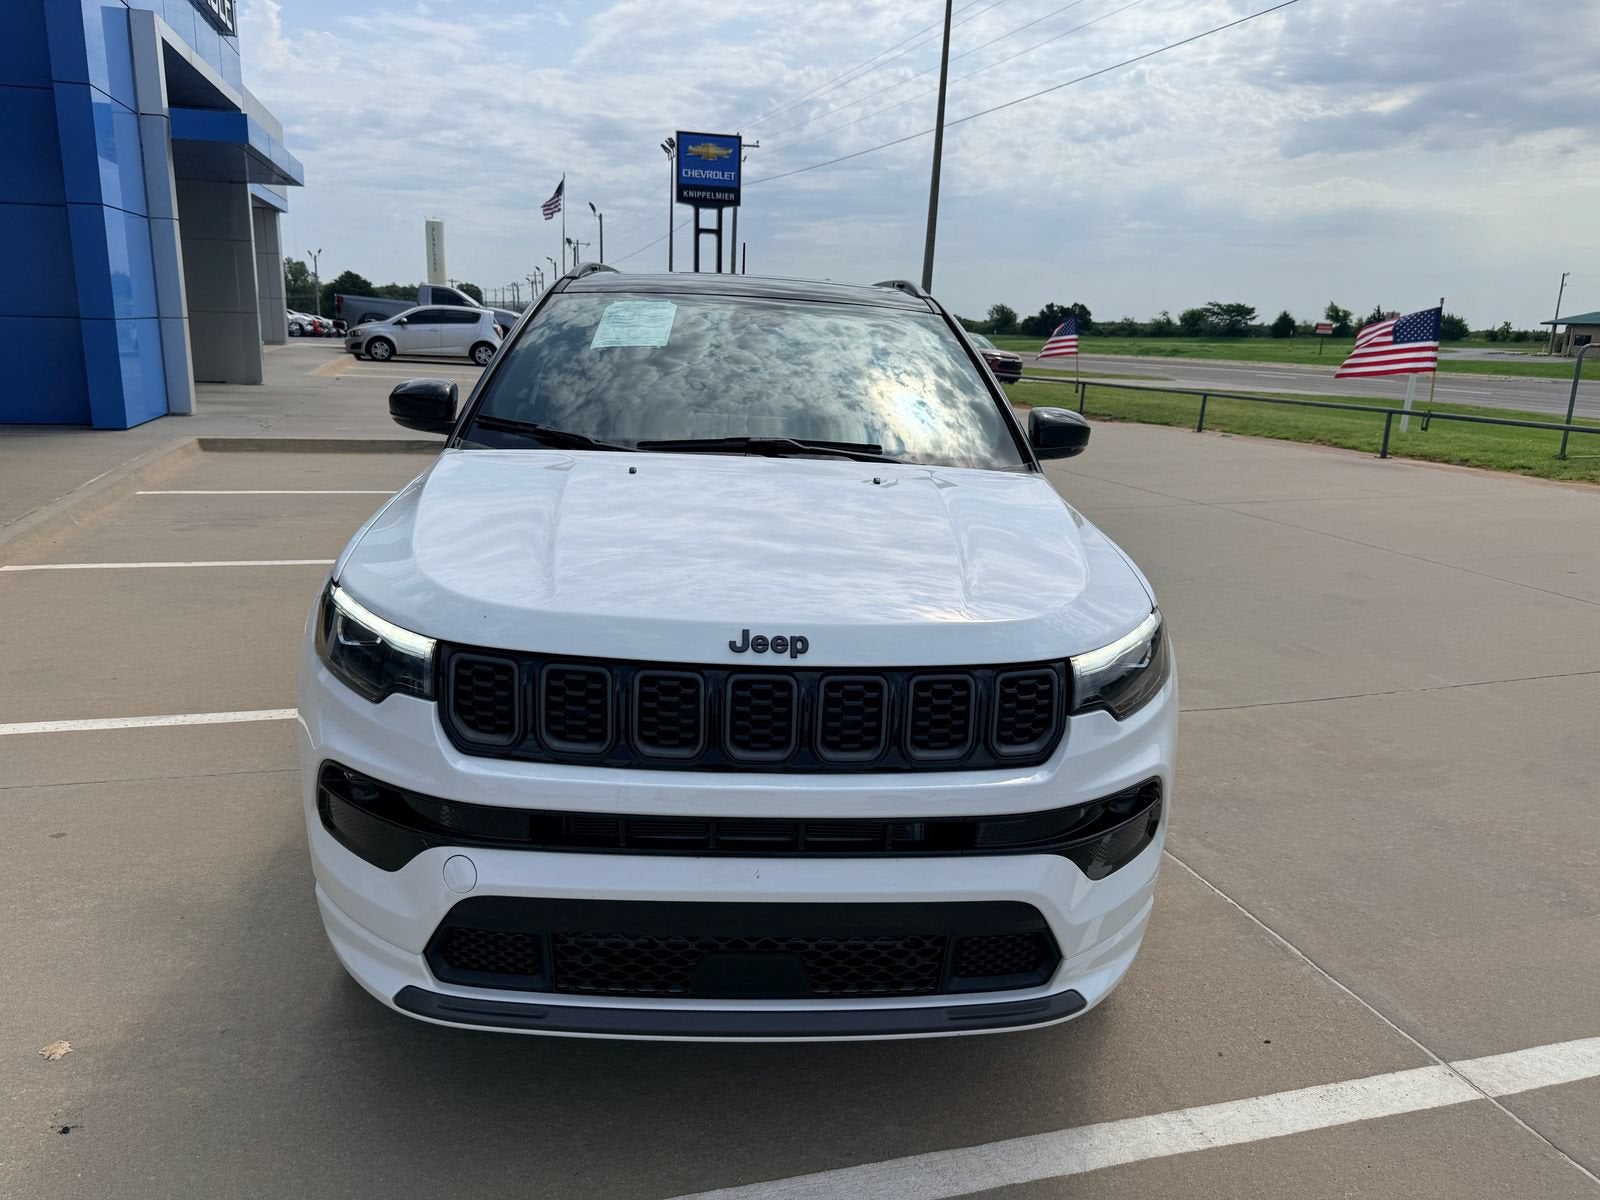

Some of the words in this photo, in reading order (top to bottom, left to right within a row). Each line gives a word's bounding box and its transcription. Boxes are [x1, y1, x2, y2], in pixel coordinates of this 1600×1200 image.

[682, 168, 736, 180] CHEVROLET
[683, 190, 735, 200] KNIPPELMIER
[729, 629, 809, 659] Jeep
